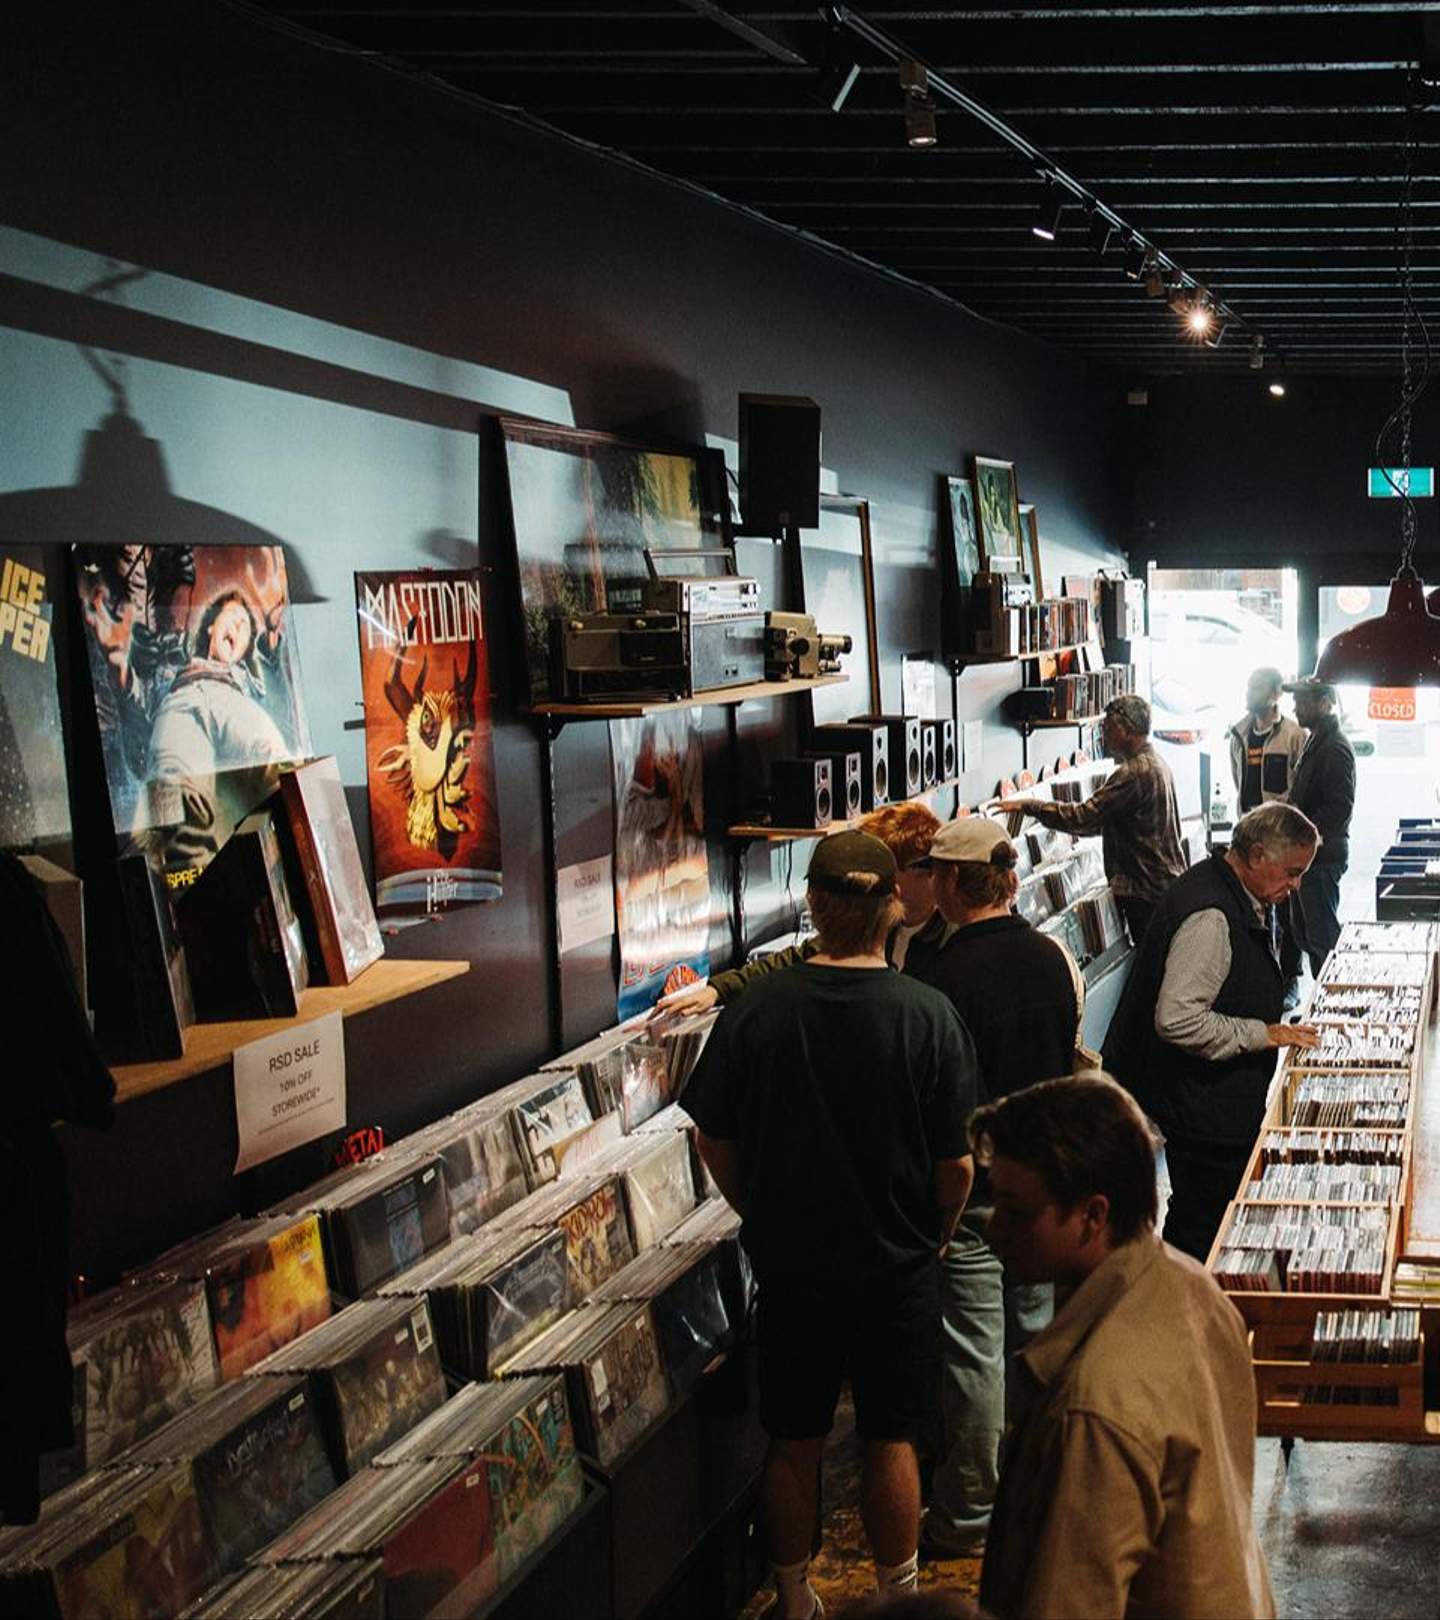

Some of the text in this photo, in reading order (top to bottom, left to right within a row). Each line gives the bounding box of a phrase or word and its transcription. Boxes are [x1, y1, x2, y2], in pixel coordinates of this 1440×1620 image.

[363, 579, 484, 650] MASTODON
[1369, 703, 1415, 719] CLOSED
[268, 1039, 321, 1073] RSD SALE
[279, 1069, 313, 1093] 10% OFF
